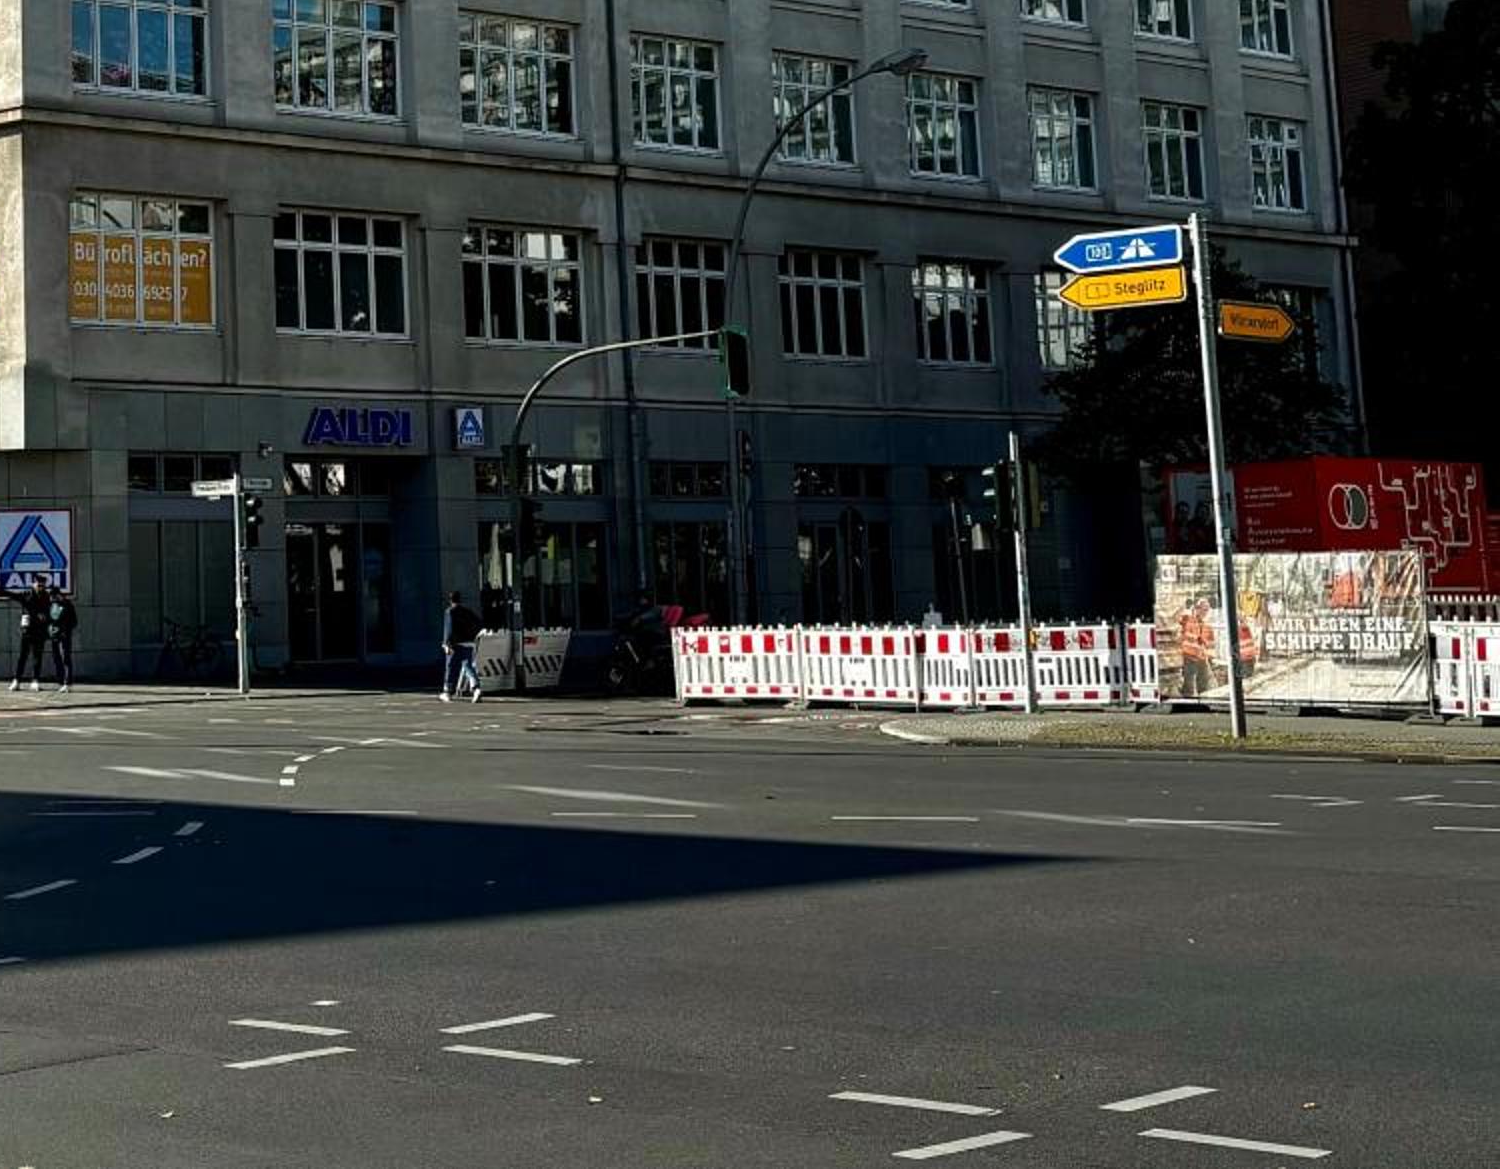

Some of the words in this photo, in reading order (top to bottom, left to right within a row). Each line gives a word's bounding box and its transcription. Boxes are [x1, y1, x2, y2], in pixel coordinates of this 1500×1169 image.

[74, 241, 207, 267] Büroflächen?
[1115, 277, 1166, 297] Steglitz
[305, 406, 412, 446] ALDI
[1271, 617, 1305, 631] WIR
[1309, 617, 1361, 631] LEGEN
[1365, 617, 1407, 631] EINE
[1265, 633, 1345, 649] SCHIPPE
[1347, 633, 1420, 650] DRAUF.
